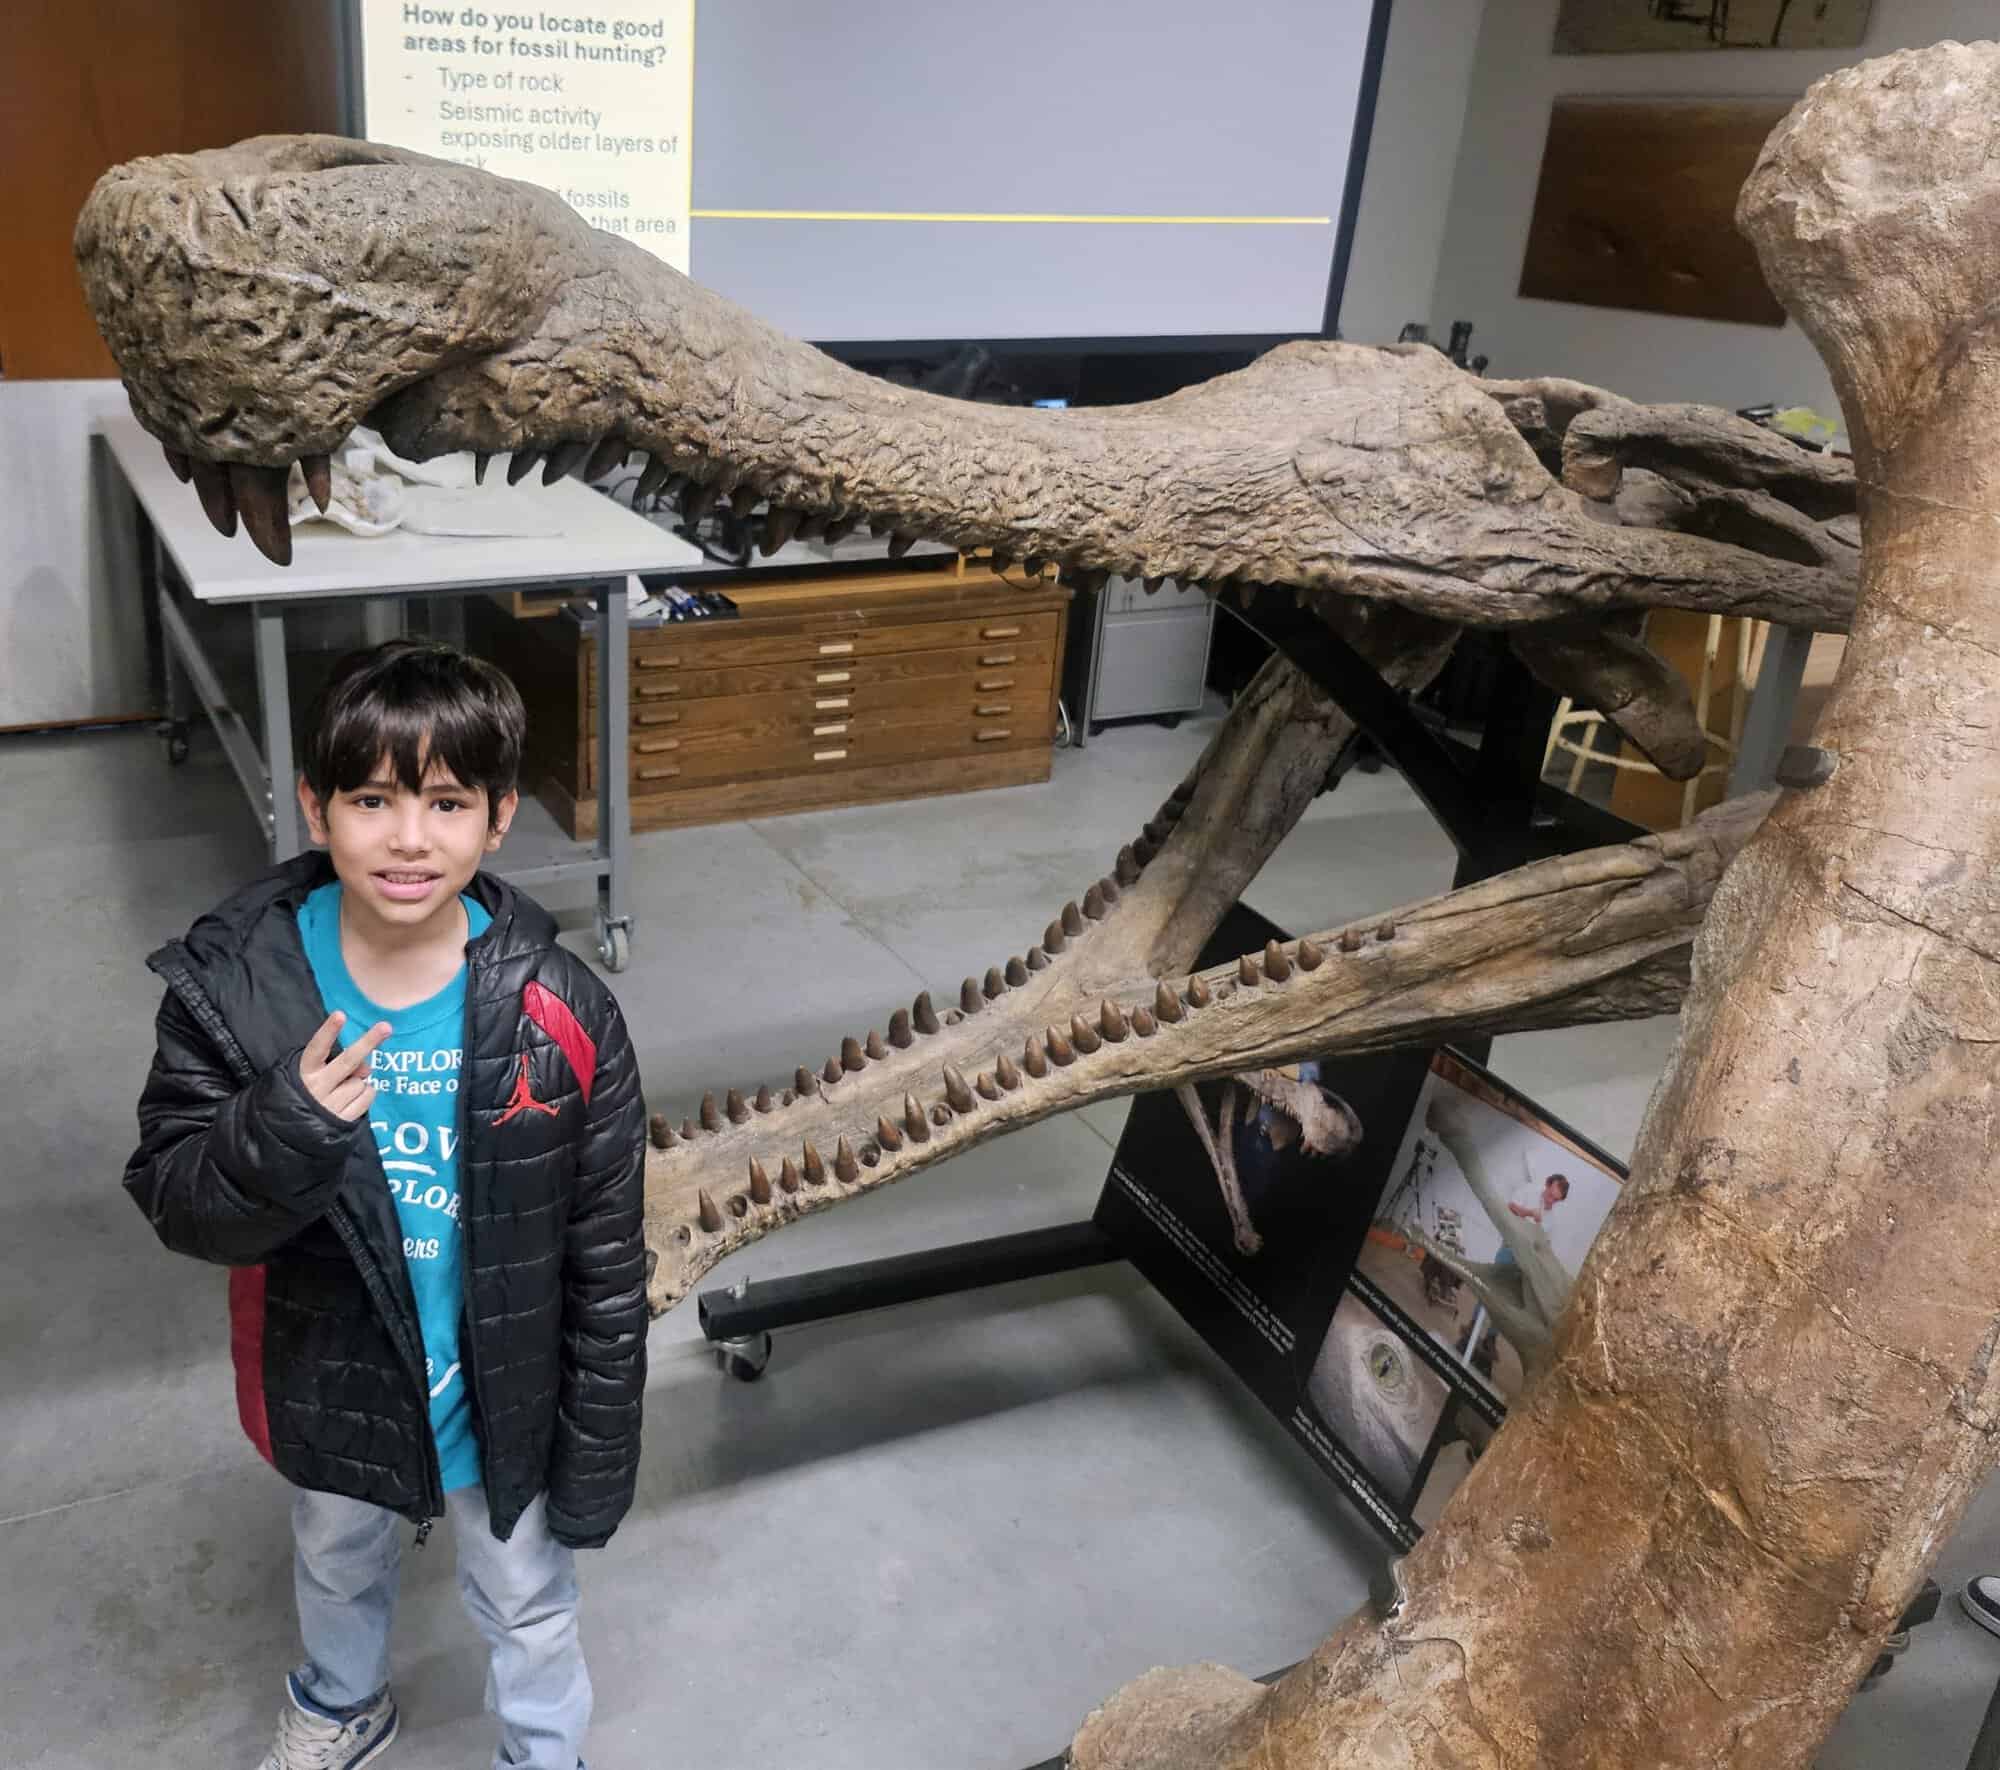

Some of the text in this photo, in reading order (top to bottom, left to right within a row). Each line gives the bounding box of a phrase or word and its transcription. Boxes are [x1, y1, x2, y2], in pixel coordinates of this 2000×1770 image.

[403, 4, 664, 40] How do you locate good
[404, 35, 666, 67] areas for fossil hunting?
[438, 67, 564, 92] Type of rock
[439, 101, 602, 129] Seismic activity
[441, 129, 678, 156] exposing older layers of
[566, 189, 631, 208] fossils
[634, 218, 677, 233] area
[395, 1076, 442, 1095] Face
